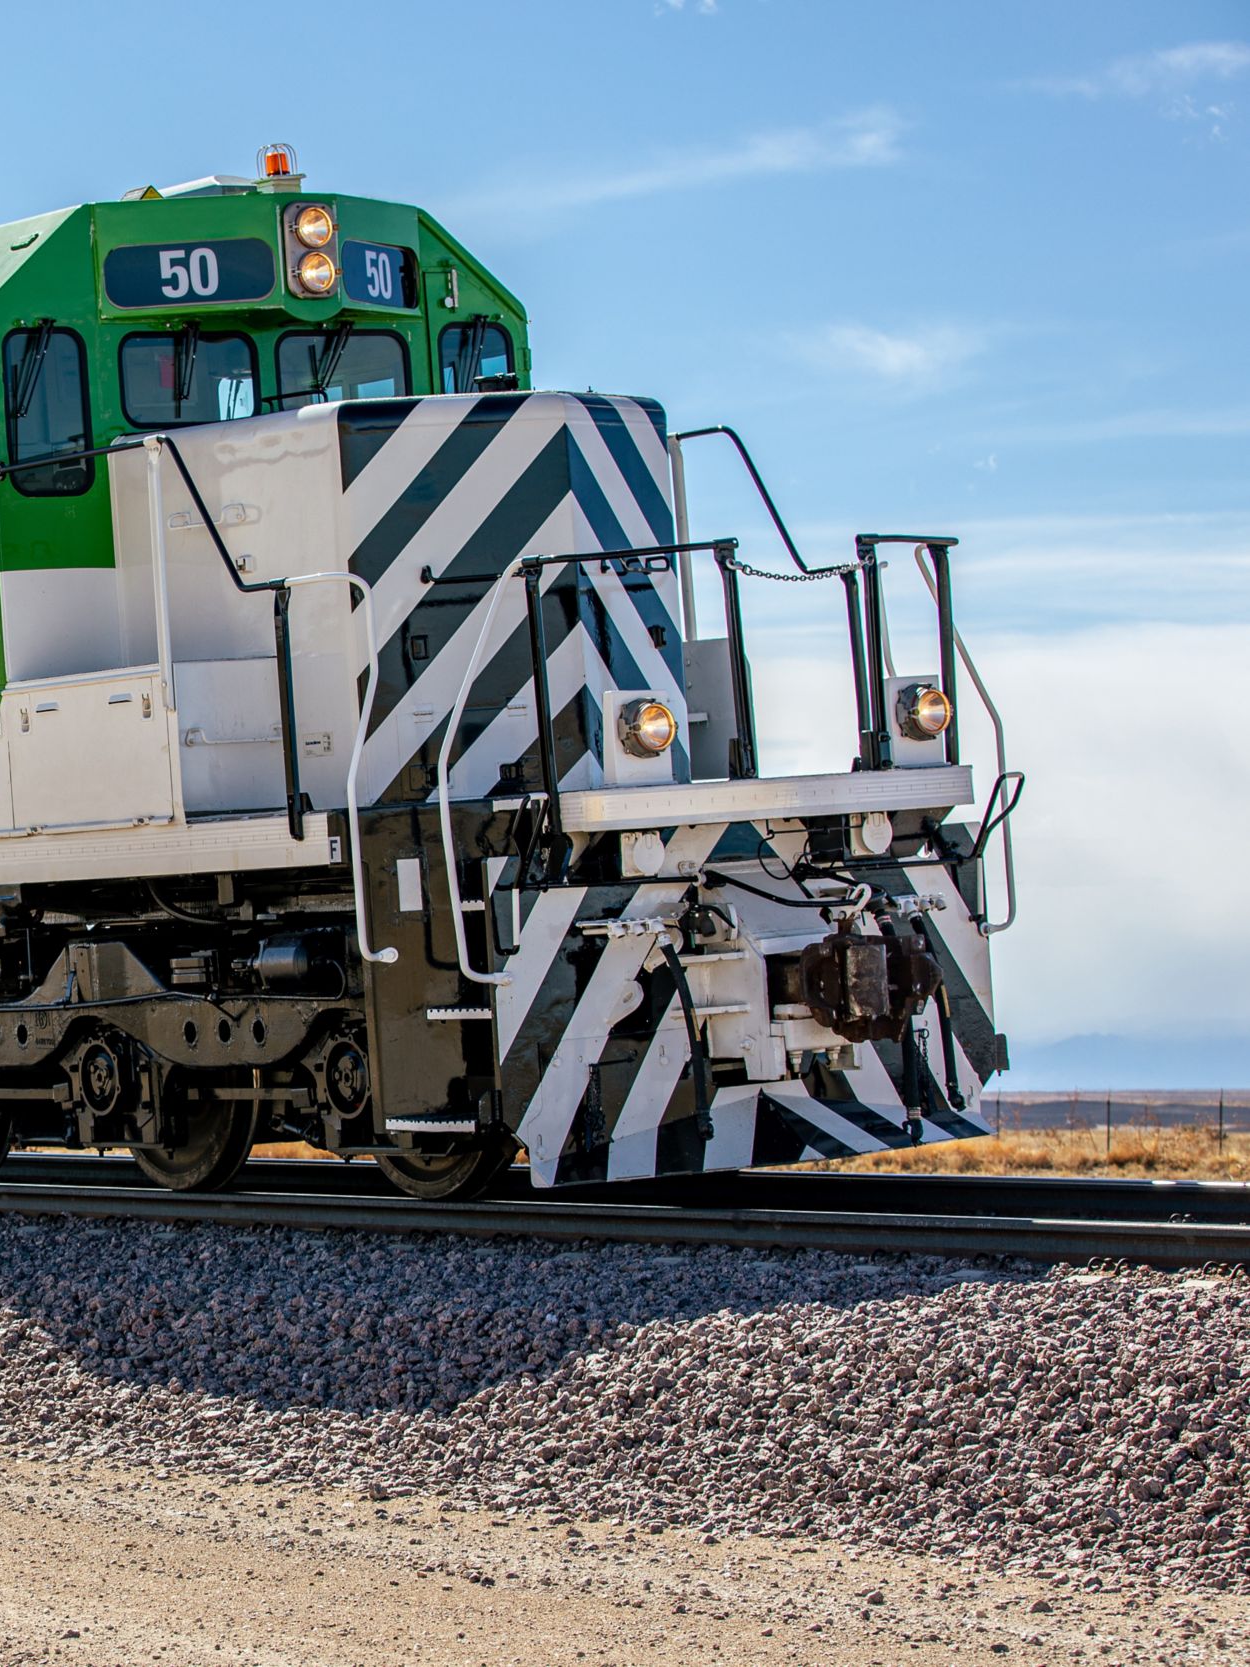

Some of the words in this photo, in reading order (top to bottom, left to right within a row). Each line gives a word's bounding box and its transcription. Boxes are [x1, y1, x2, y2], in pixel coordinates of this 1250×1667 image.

[158, 247, 219, 299] 50
[365, 250, 393, 300] 50
[330, 839, 338, 860] F
